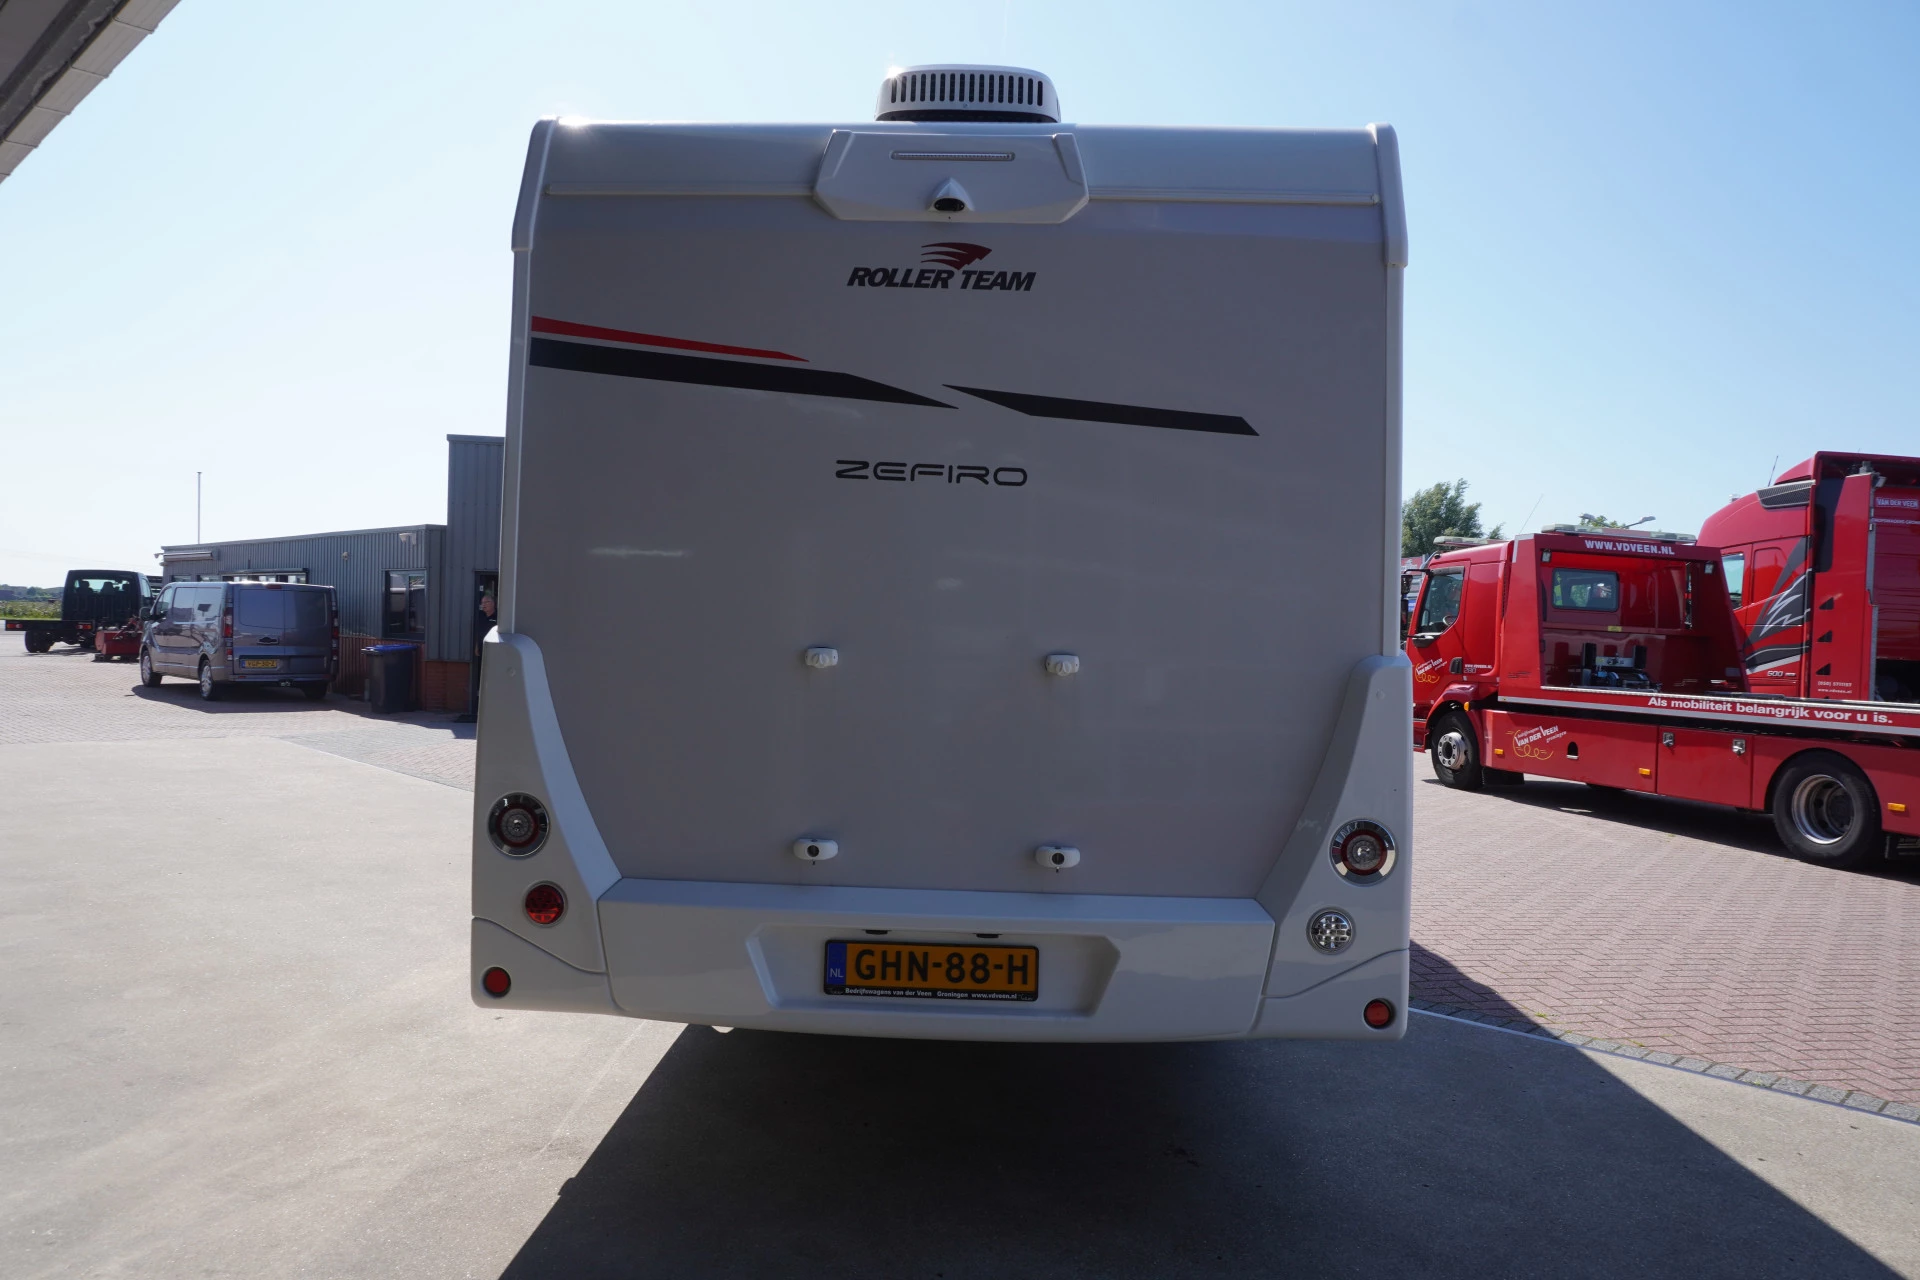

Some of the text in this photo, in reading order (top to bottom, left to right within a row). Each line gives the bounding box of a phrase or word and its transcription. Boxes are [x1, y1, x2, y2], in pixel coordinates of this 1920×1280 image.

[847, 267, 1037, 292] ROLLER TEAM
[835, 459, 1028, 487] ZEFIRO
[1584, 539, 1675, 555] WWW.VDVEEN.NL
[1647, 696, 1893, 724] Als mobiliteit belangrijk voor u is.
[1514, 725, 1559, 747] VAN DER VEEN
[829, 967, 844, 978] NL
[855, 948, 1029, 986] GHN-88-H
[845, 987, 892, 996] Bedrijfswagens
[937, 990, 969, 999] Groningen
